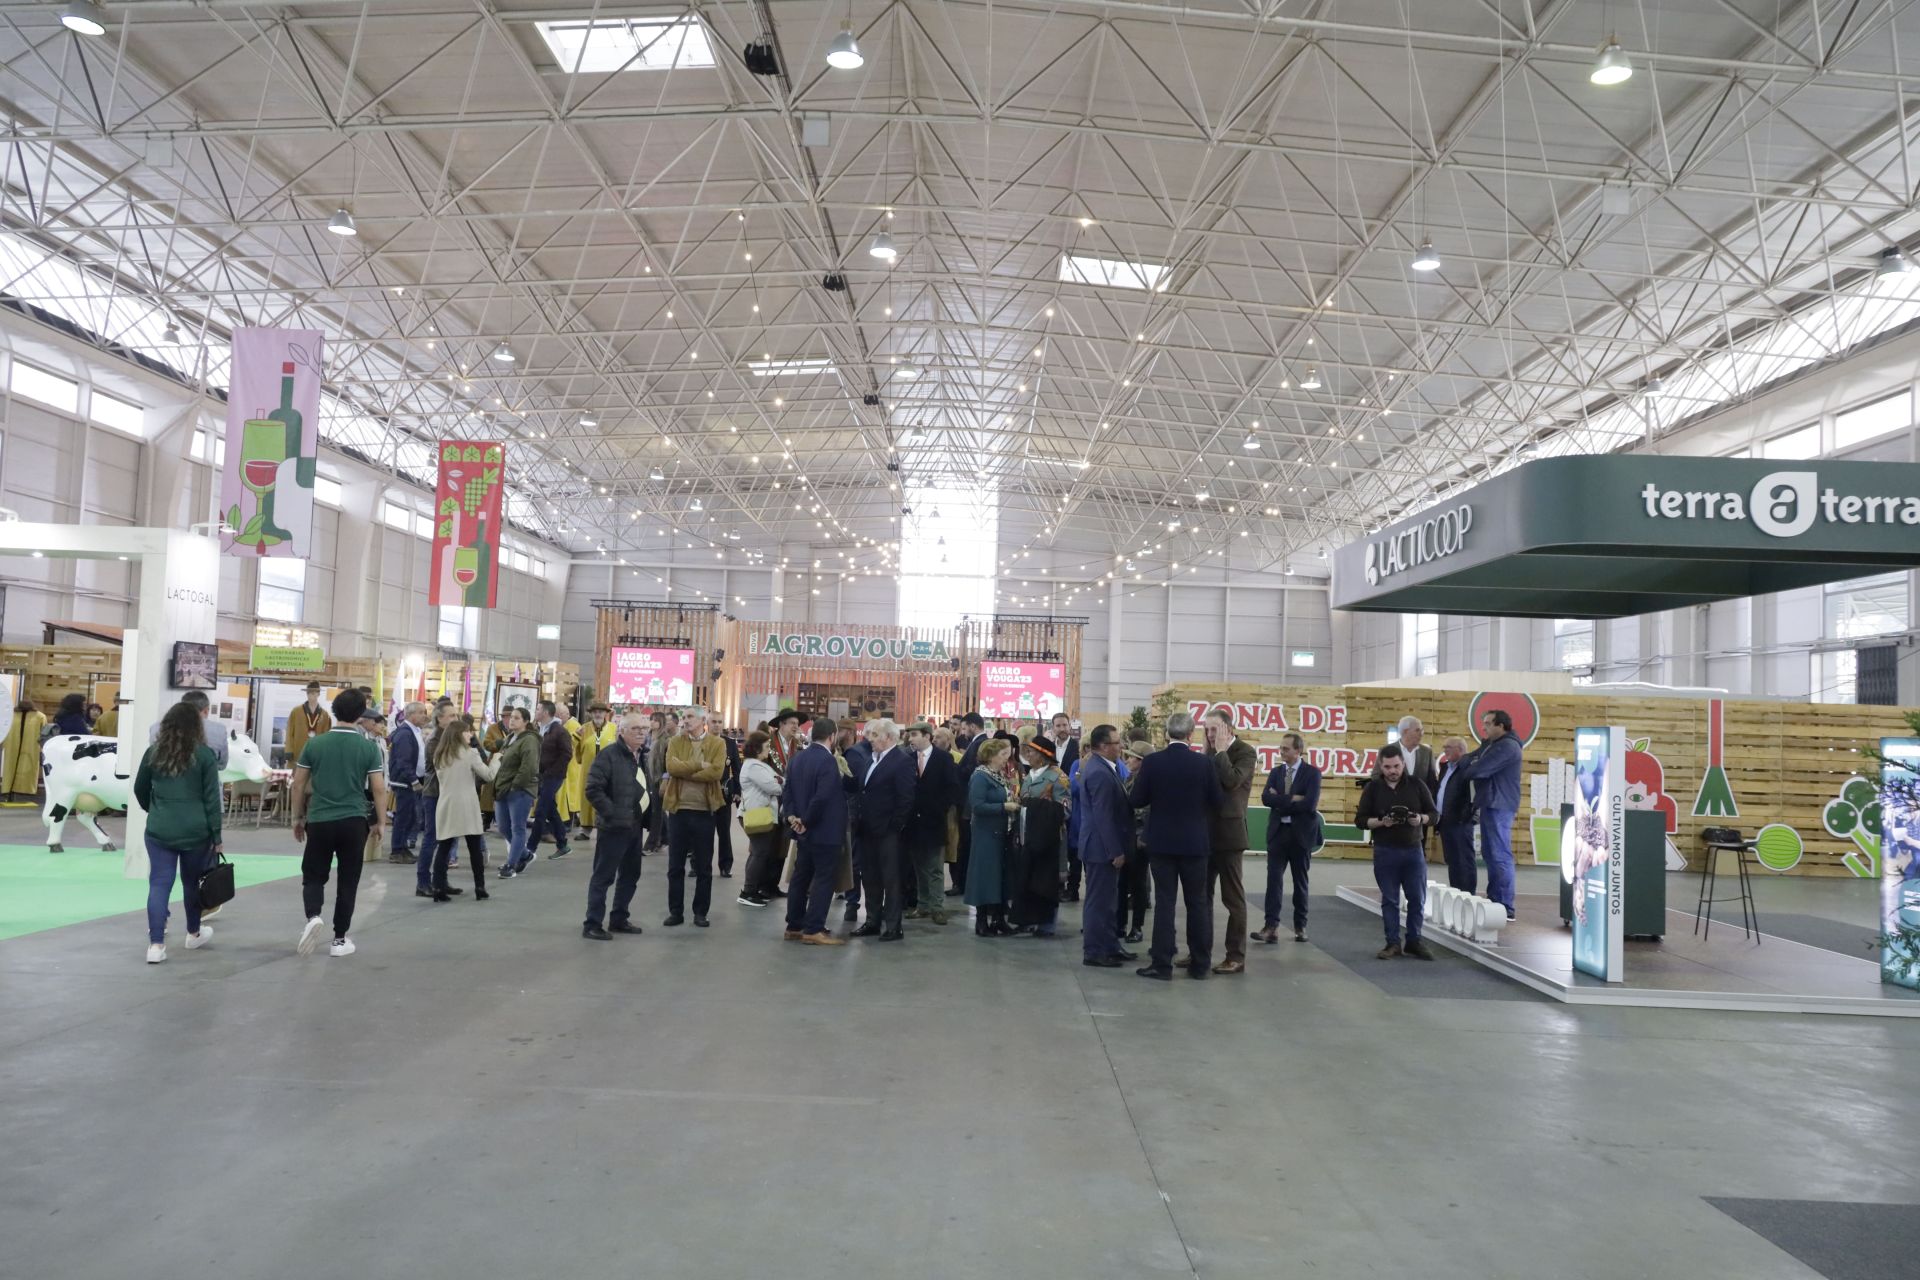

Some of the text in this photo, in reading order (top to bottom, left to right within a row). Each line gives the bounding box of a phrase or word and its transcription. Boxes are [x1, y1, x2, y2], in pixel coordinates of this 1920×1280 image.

[1641, 483, 1746, 520] terra
[1820, 488, 1920, 525] terra
[1380, 504, 1473, 577] LACTICOOP
[167, 587, 214, 606] LACTOGAL
[622, 652, 651, 660] AGRO
[991, 666, 1020, 674] AGRO
[1299, 705, 1346, 732] DE
[1611, 795, 1622, 916] CULTIVAMOS JUNTOS
